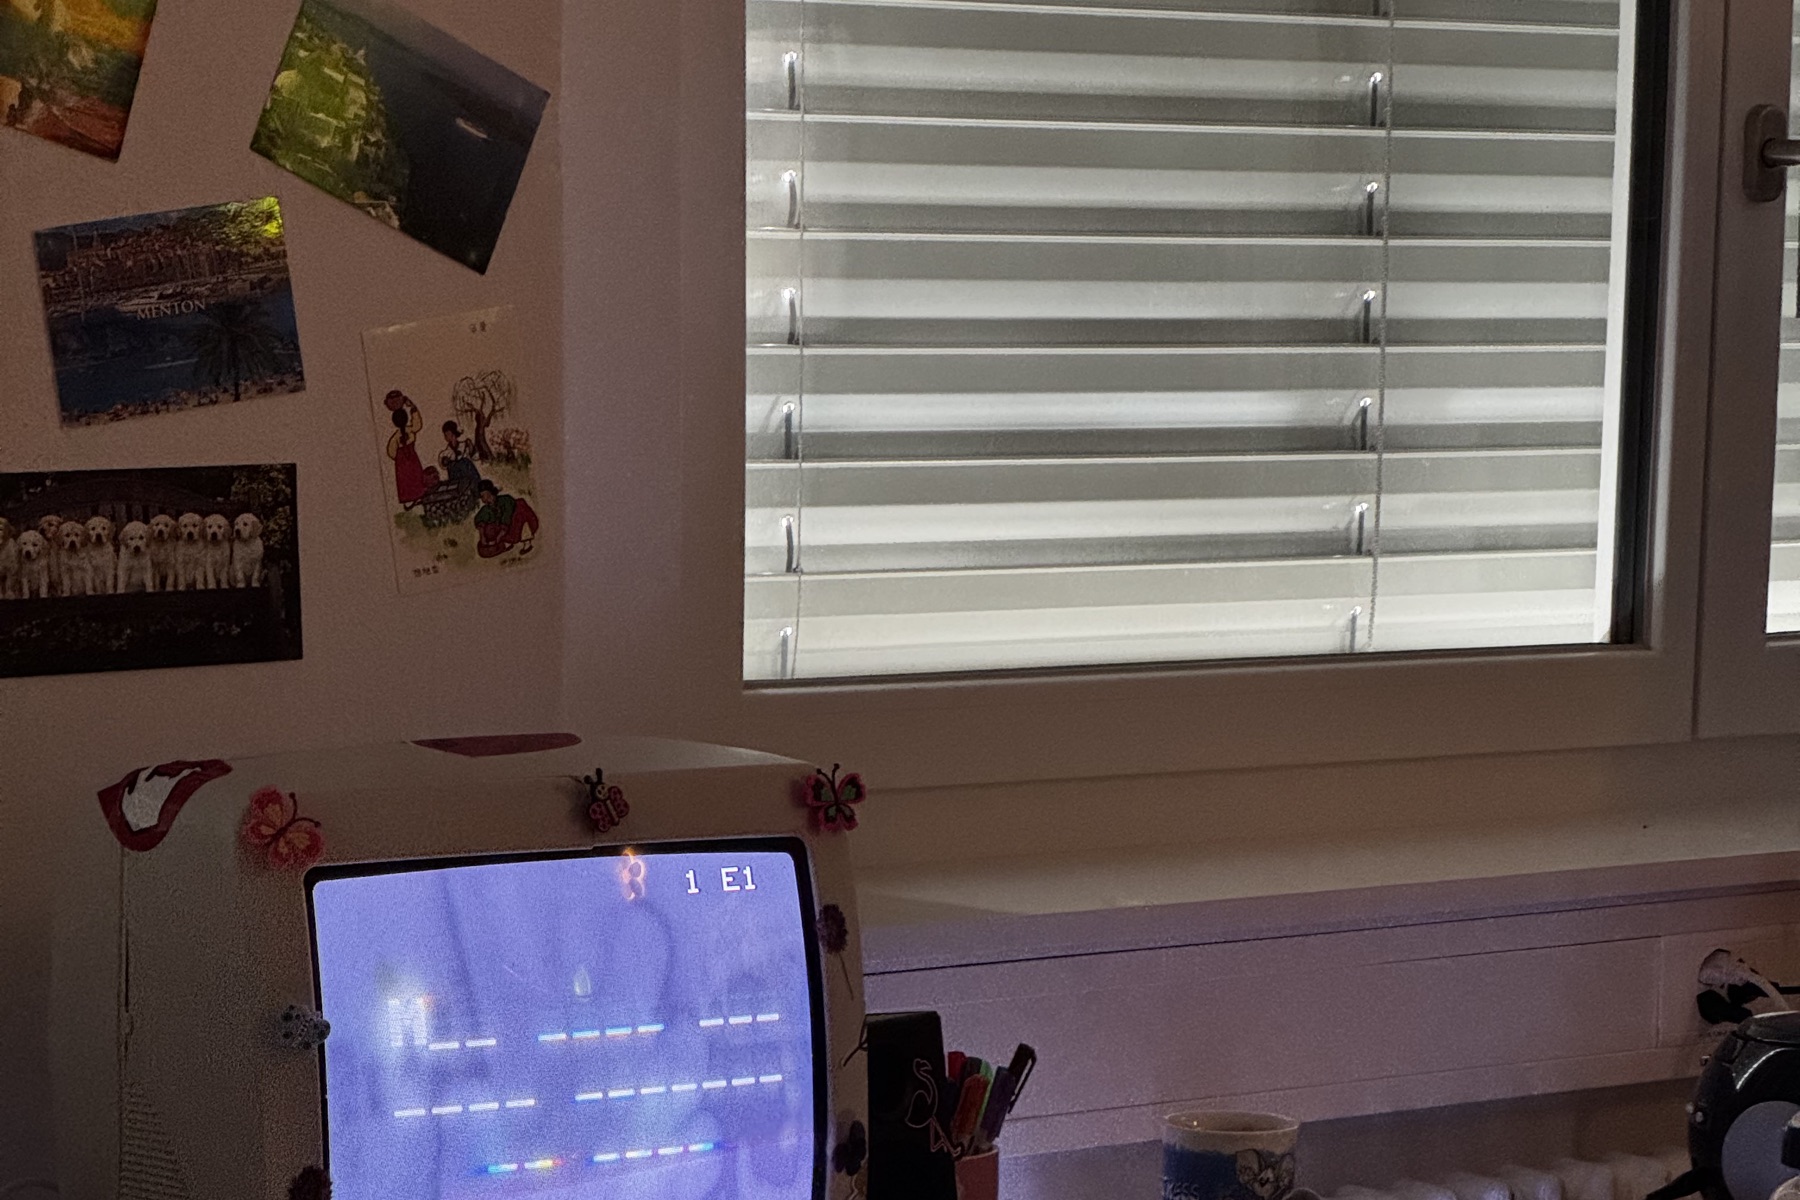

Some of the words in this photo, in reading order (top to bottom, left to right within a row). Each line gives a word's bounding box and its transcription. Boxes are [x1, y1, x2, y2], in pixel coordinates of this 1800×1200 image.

[136, 299, 207, 321] MENTON
[685, 869, 700, 894] 1
[720, 865, 757, 892] E1
